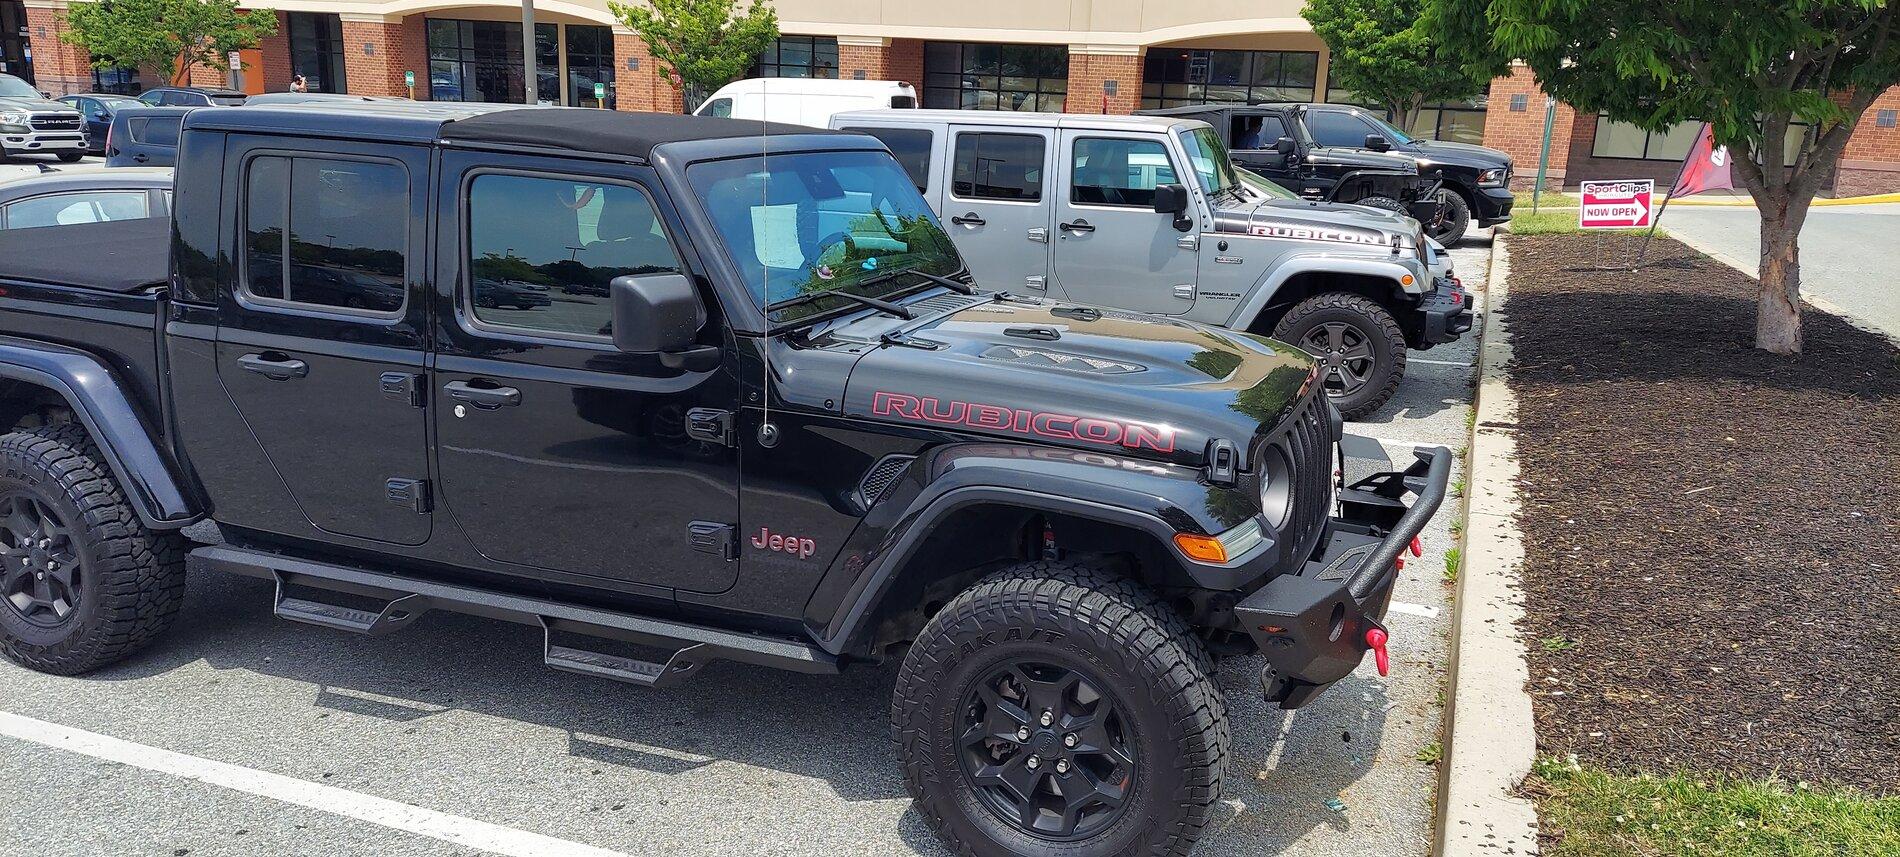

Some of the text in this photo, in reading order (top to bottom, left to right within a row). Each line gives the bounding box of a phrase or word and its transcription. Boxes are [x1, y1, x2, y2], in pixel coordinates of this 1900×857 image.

[1586, 184, 1648, 195] SportClips
[1586, 207, 1638, 217] NOW OPEN
[1251, 225, 1380, 244] RUBICON
[872, 391, 1176, 453] RUBICON
[751, 527, 816, 560] Jeep
